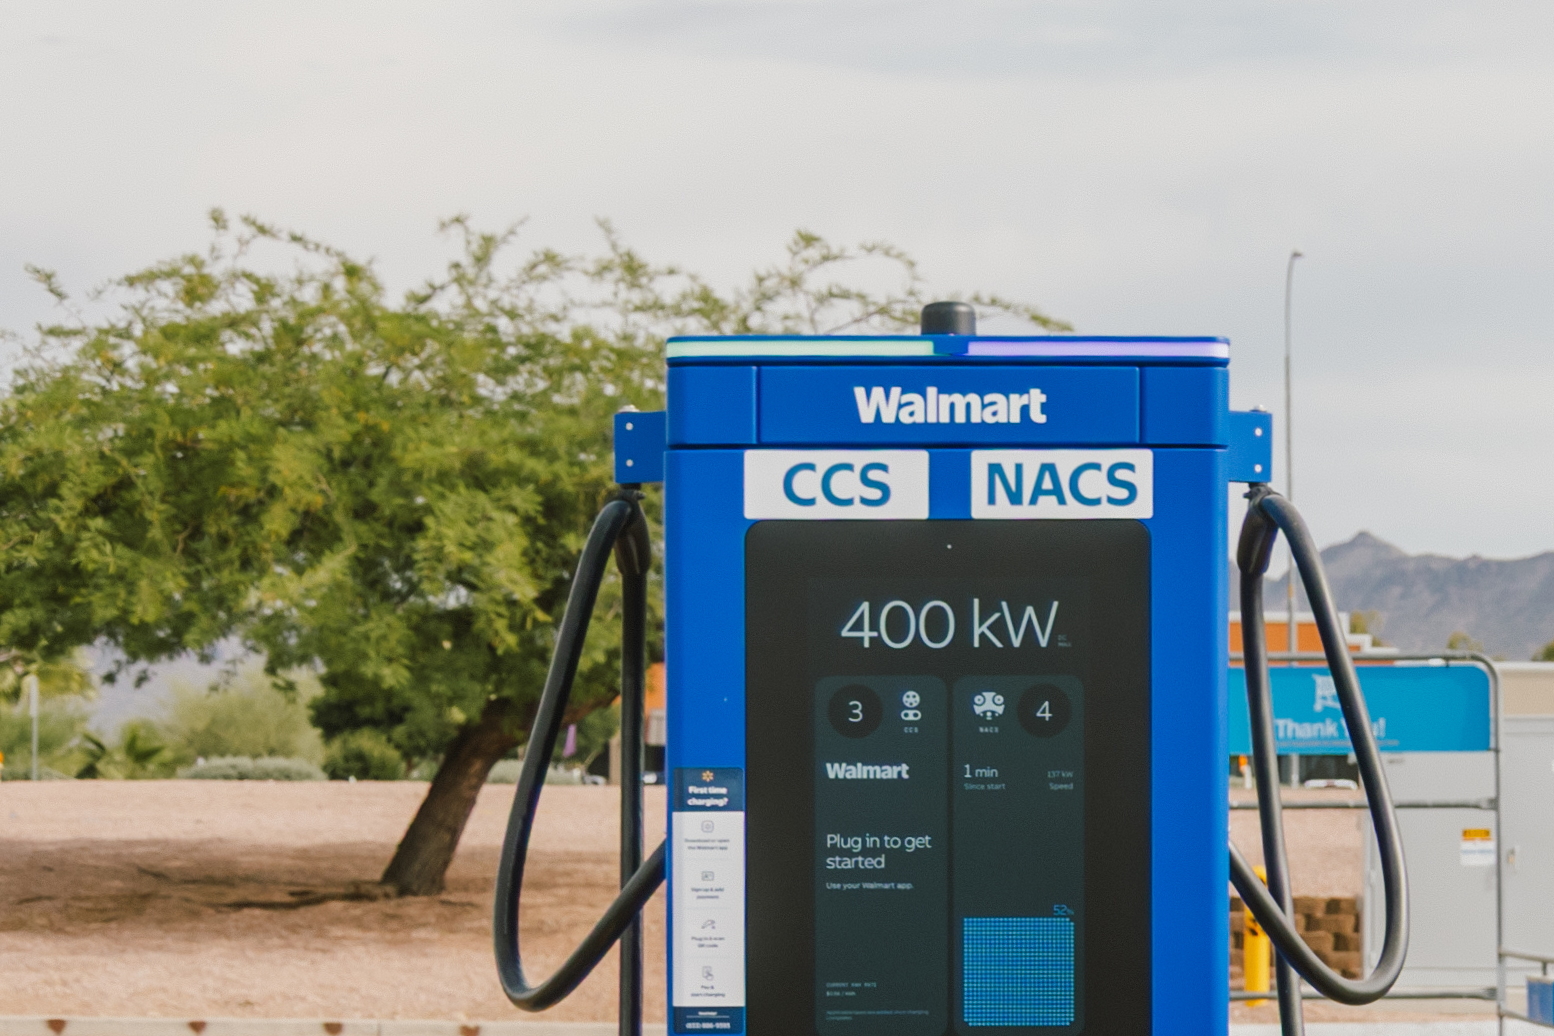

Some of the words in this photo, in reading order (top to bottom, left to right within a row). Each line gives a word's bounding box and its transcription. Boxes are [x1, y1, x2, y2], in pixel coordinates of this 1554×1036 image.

[853, 386, 1047, 425] Walmart
[782, 461, 892, 507] CCS
[987, 461, 1138, 507] NACS
[840, 600, 955, 649] 400
[973, 597, 1059, 648] kW
[848, 700, 863, 723] 3
[1035, 700, 1053, 722] 4
[1274, 718, 1339, 739] Thank
[825, 762, 910, 780] Walmart
[963, 763, 973, 778] 1
[975, 766, 999, 778] min
[688, 785, 707, 794] First
[708, 785, 728, 794] time
[1048, 782, 1074, 791] Speed
[826, 833, 862, 853] Plug
[865, 833, 881, 849] in
[883, 835, 902, 849] to
[904, 835, 932, 853] get
[825, 854, 886, 870] started
[825, 881, 841, 889] Use
[843, 882, 861, 891] your
[861, 881, 895, 889] Walmart
